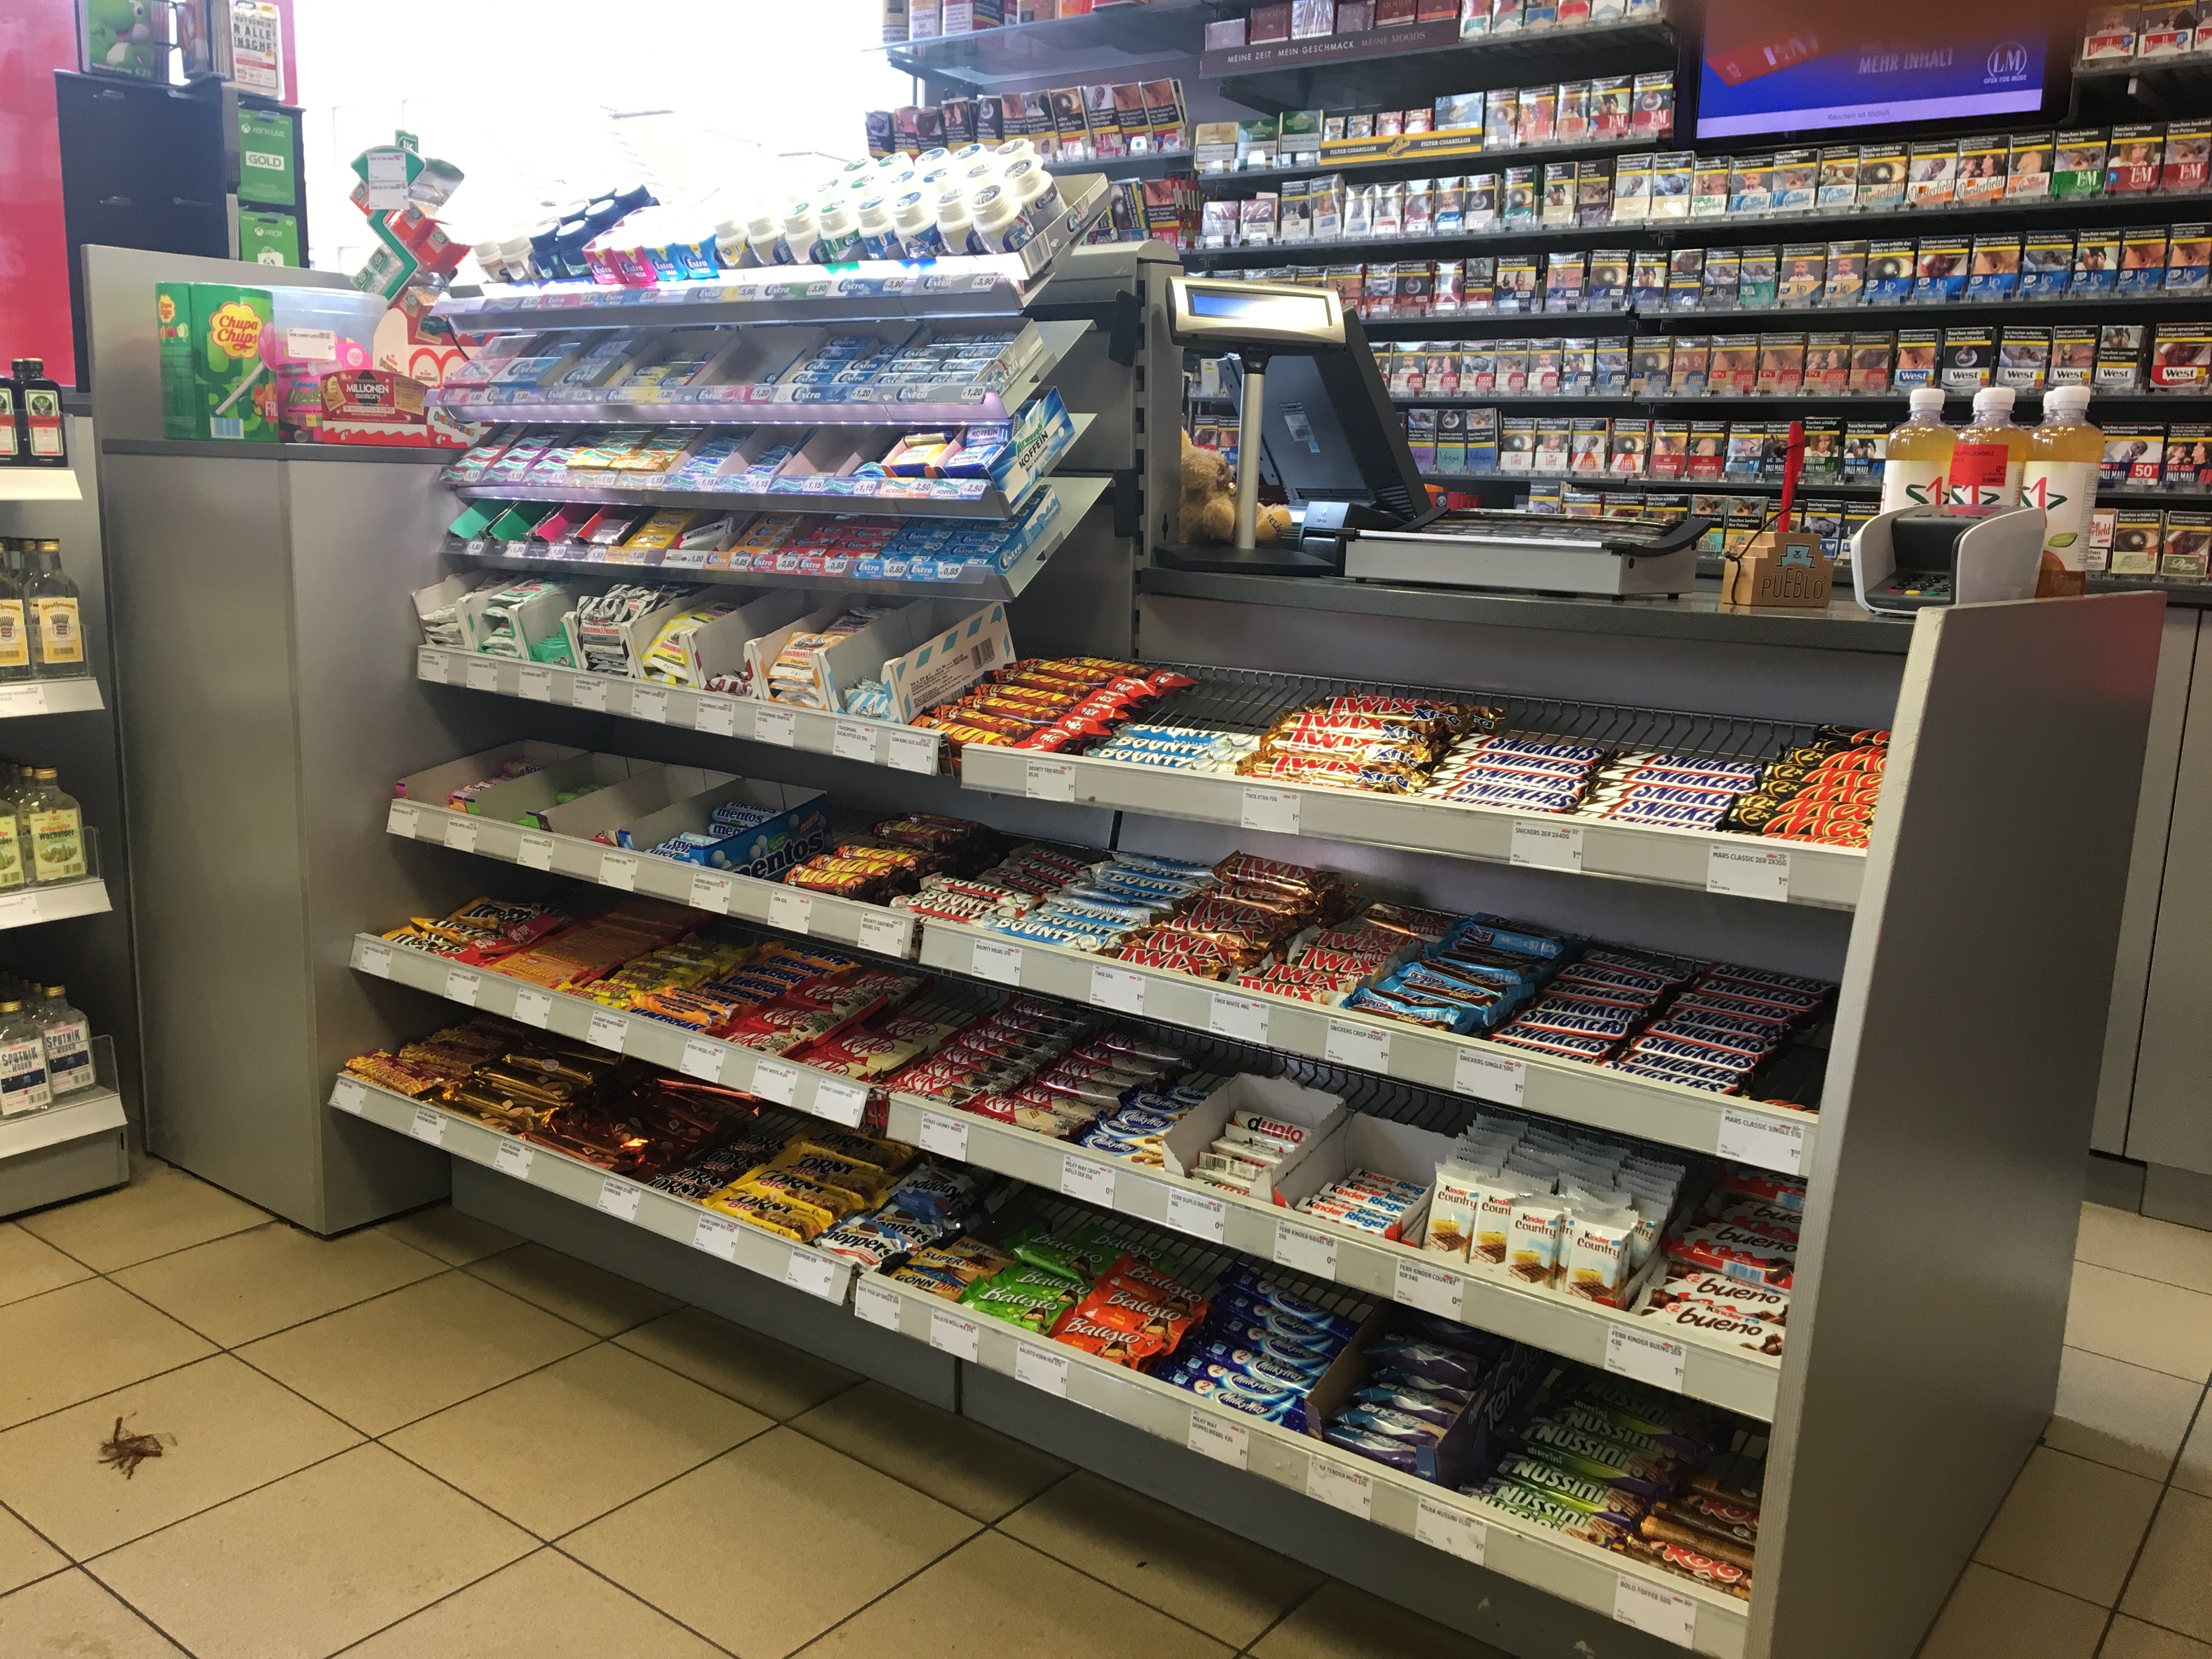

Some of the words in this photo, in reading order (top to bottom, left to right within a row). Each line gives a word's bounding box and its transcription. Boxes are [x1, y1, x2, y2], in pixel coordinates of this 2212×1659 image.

[1228, 54, 1251, 63] MEINE
[1278, 48, 1299, 56] MEIN
[1391, 31, 1425, 43] MOODS
[1904, 47, 1953, 70] INHALT
[1827, 112, 1855, 121] Rauchen
[249, 154, 281, 167] GOLD
[219, 315, 258, 333] Chupa
[217, 329, 258, 350] Chups
[1952, 370, 1979, 379] West
[2007, 370, 2034, 379] West
[347, 384, 389, 393] MILLIONEN
[972, 428, 998, 437] KOFFEIN
[1018, 431, 1049, 469] KOFFEIN
[1583, 459, 1593, 467] HB
[1622, 459, 1633, 469] HB
[2135, 465, 2153, 477] 50
[1760, 567, 1824, 599] PUEBLO
[1325, 696, 1420, 714] TWIX
[1295, 713, 1388, 730] TWIX
[1116, 736, 1208, 755] BOUNTY
[1355, 770, 1409, 788] Xtra
[1458, 782, 1578, 811] SNICKERS
[716, 809, 765, 823] mentos
[1749, 808, 1770, 821] 2x
[1515, 827, 1539, 836] SNICKERS
[854, 847, 914, 862] LION
[1712, 851, 1729, 859] MARS
[1730, 853, 1754, 862] CLASSIC
[800, 869, 853, 885] LION
[995, 917, 1080, 944] BOUNTY
[1214, 997, 1227, 1005] TWIX
[1227, 998, 1239, 1008] WHITE
[1239, 1002, 1250, 1010] 46G
[46, 1029, 81, 1048] SPUTNIK
[1330, 1025, 1353, 1035] SNICKERS
[1353, 1028, 1367, 1037] CRISP
[1, 1047, 38, 1066] SPUTNIK
[1459, 1054, 1483, 1066] SNICKERS
[1485, 1059, 1502, 1069] SINGLE
[1645, 1036, 1756, 1070] SNICKERS
[1246, 1115, 1305, 1143] duplo
[1724, 1115, 1742, 1126] MARS
[1742, 1119, 1768, 1131] CLASSIC
[1768, 1125, 1790, 1136] SINGLE
[758, 1180, 784, 1191] BIG
[726, 1200, 752, 1211] BIG
[1171, 1193, 1182, 1201] FERR
[1182, 1195, 1198, 1207] DUPLO
[1197, 1200, 1213, 1211] RIEGEL
[1279, 1226, 1290, 1234] FERR
[1291, 1228, 1308, 1239] KINDER
[1308, 1233, 1325, 1244] RIEGEL
[1515, 1220, 1557, 1239] Country
[1577, 1237, 1621, 1260] Country
[923, 1249, 962, 1267] SUPER
[894, 1272, 933, 1290] GÖNN
[1399, 1263, 1412, 1273] FERR
[1412, 1267, 1431, 1279] KINDER
[1431, 1273, 1456, 1286] COUNTRY
[978, 1285, 1059, 1312] Balisto
[1696, 1274, 1781, 1305] bueno
[1106, 1290, 1182, 1322] Balisto
[933, 1314, 949, 1324] BALISTO
[1675, 1308, 1763, 1336] bueno
[1611, 1338, 1622, 1347] 43G
[1612, 1329, 1626, 1340] FERR
[1627, 1334, 1648, 1346] KINDER
[1649, 1339, 1669, 1351] BUENO
[1193, 1415, 1206, 1424] MILKY
[1206, 1420, 1217, 1429] WAY
[1420, 1503, 1436, 1514] MILKA
[1436, 1509, 1458, 1523] NUSSINI
[1620, 1580, 1636, 1592] ROLO
[1637, 1584, 1658, 1601] TOFFEE
